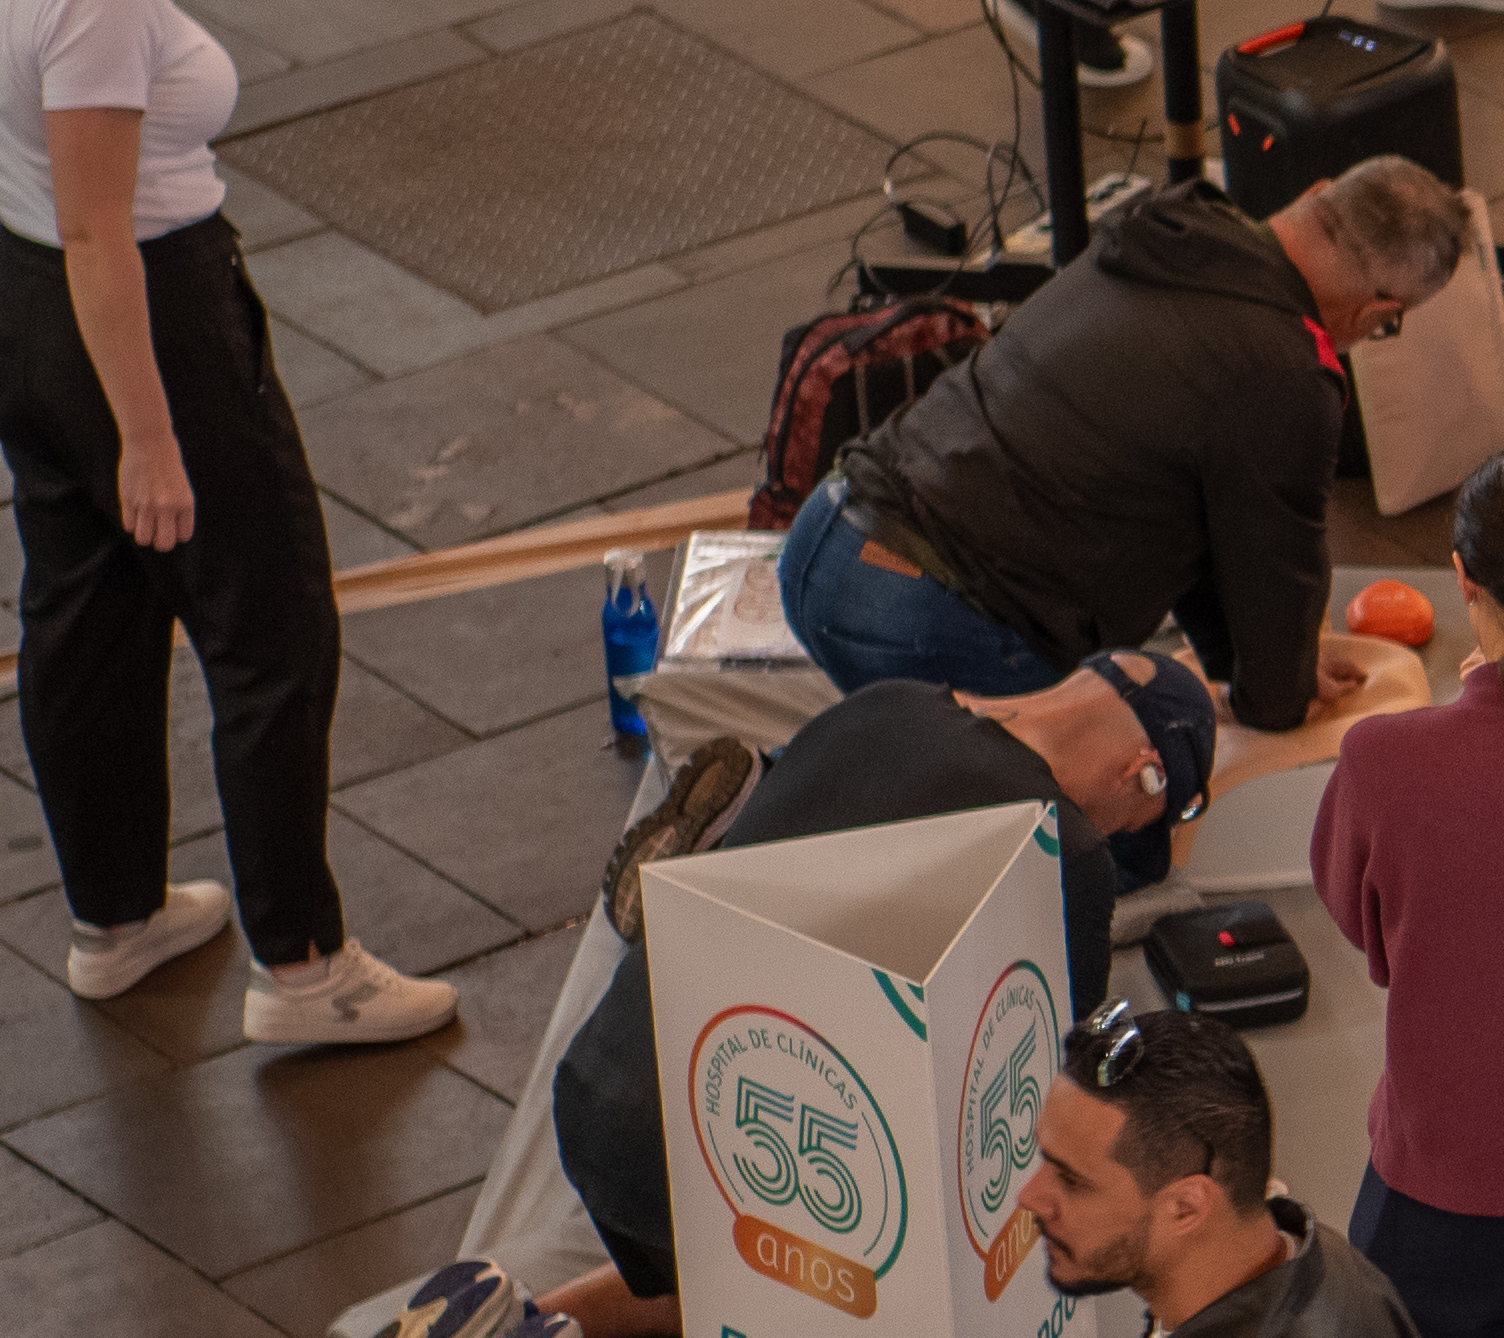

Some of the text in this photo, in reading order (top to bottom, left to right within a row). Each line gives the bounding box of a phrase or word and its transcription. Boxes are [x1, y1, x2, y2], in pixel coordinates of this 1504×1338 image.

[705, 1032, 749, 1117] HOSPITAL
[748, 1027, 772, 1050] DE
[966, 1058, 984, 1177] HOSPITAL
[982, 1019, 994, 1051] DE
[980, 1016, 1041, 1212] 55
[733, 1075, 862, 1234] 55
[756, 1232, 857, 1304] anos
[994, 1208, 1034, 1283] ano
